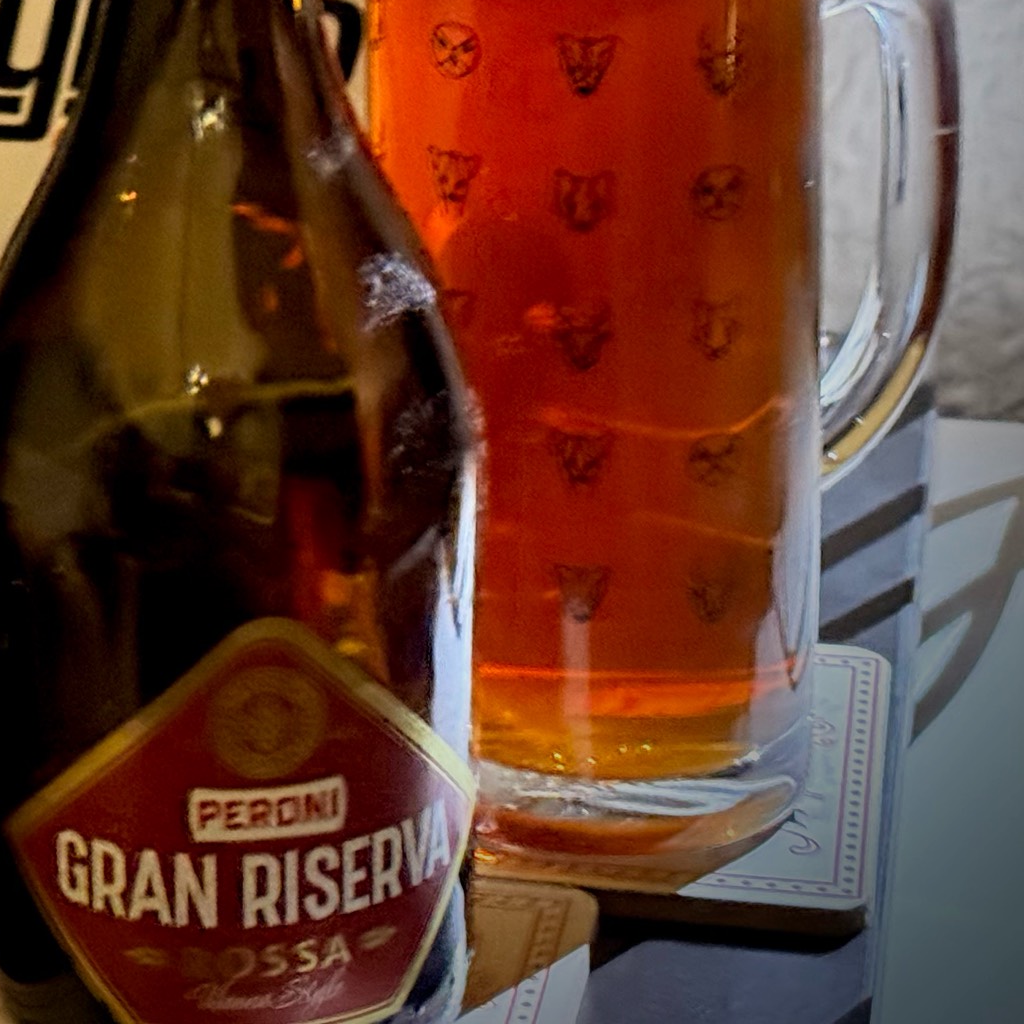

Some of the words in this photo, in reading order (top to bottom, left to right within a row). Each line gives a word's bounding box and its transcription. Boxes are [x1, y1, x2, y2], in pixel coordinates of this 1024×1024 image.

[198, 787, 340, 831] PERONI
[54, 829, 219, 929] GRAN
[242, 799, 452, 929] RISERVA
[180, 934, 353, 977] ROSSA
